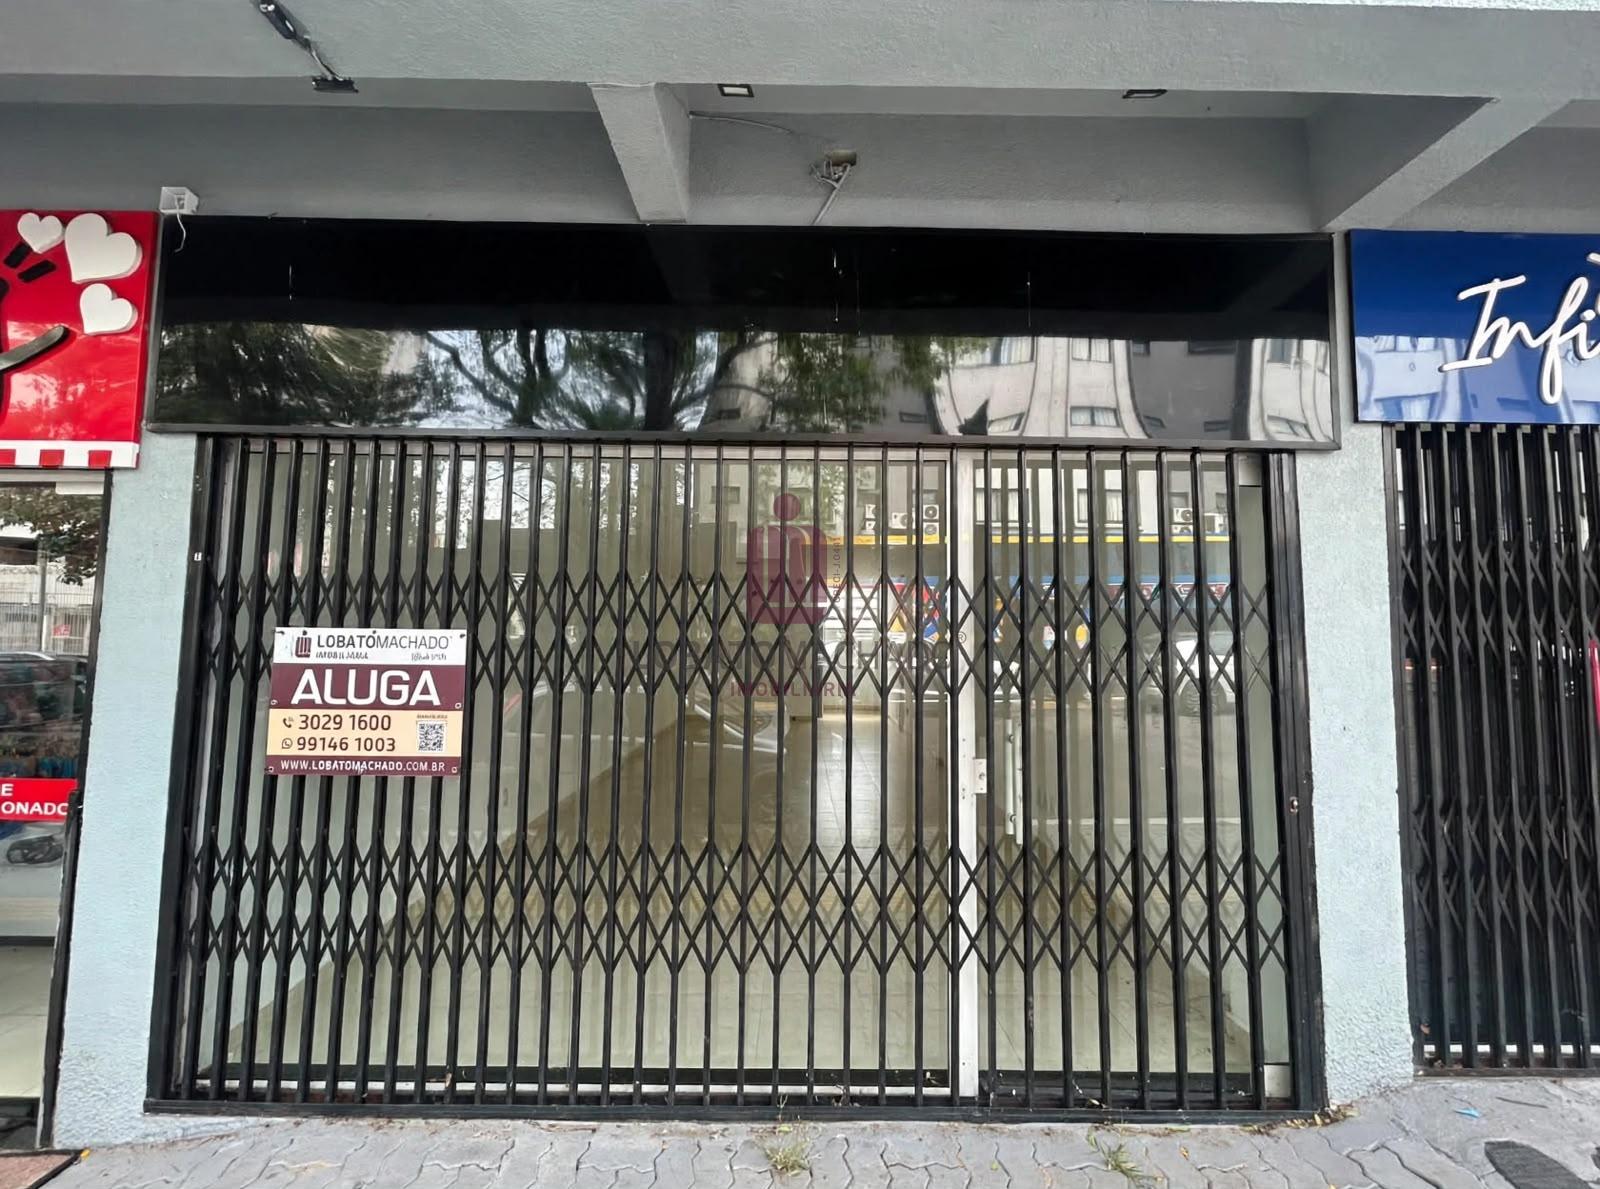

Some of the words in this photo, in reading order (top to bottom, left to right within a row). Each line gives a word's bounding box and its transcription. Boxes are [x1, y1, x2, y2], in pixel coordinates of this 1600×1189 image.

[1438, 273, 1600, 405] Infi
[316, 634, 449, 651] LOBATOMACHADO
[291, 668, 441, 706] ALUGA
[298, 714, 343, 731] 3029
[349, 714, 391, 731] 1600
[297, 736, 349, 752] 99146
[355, 737, 396, 752] 1003
[280, 759, 445, 773] WWW.LOBATOMACHADO.COM.BR
